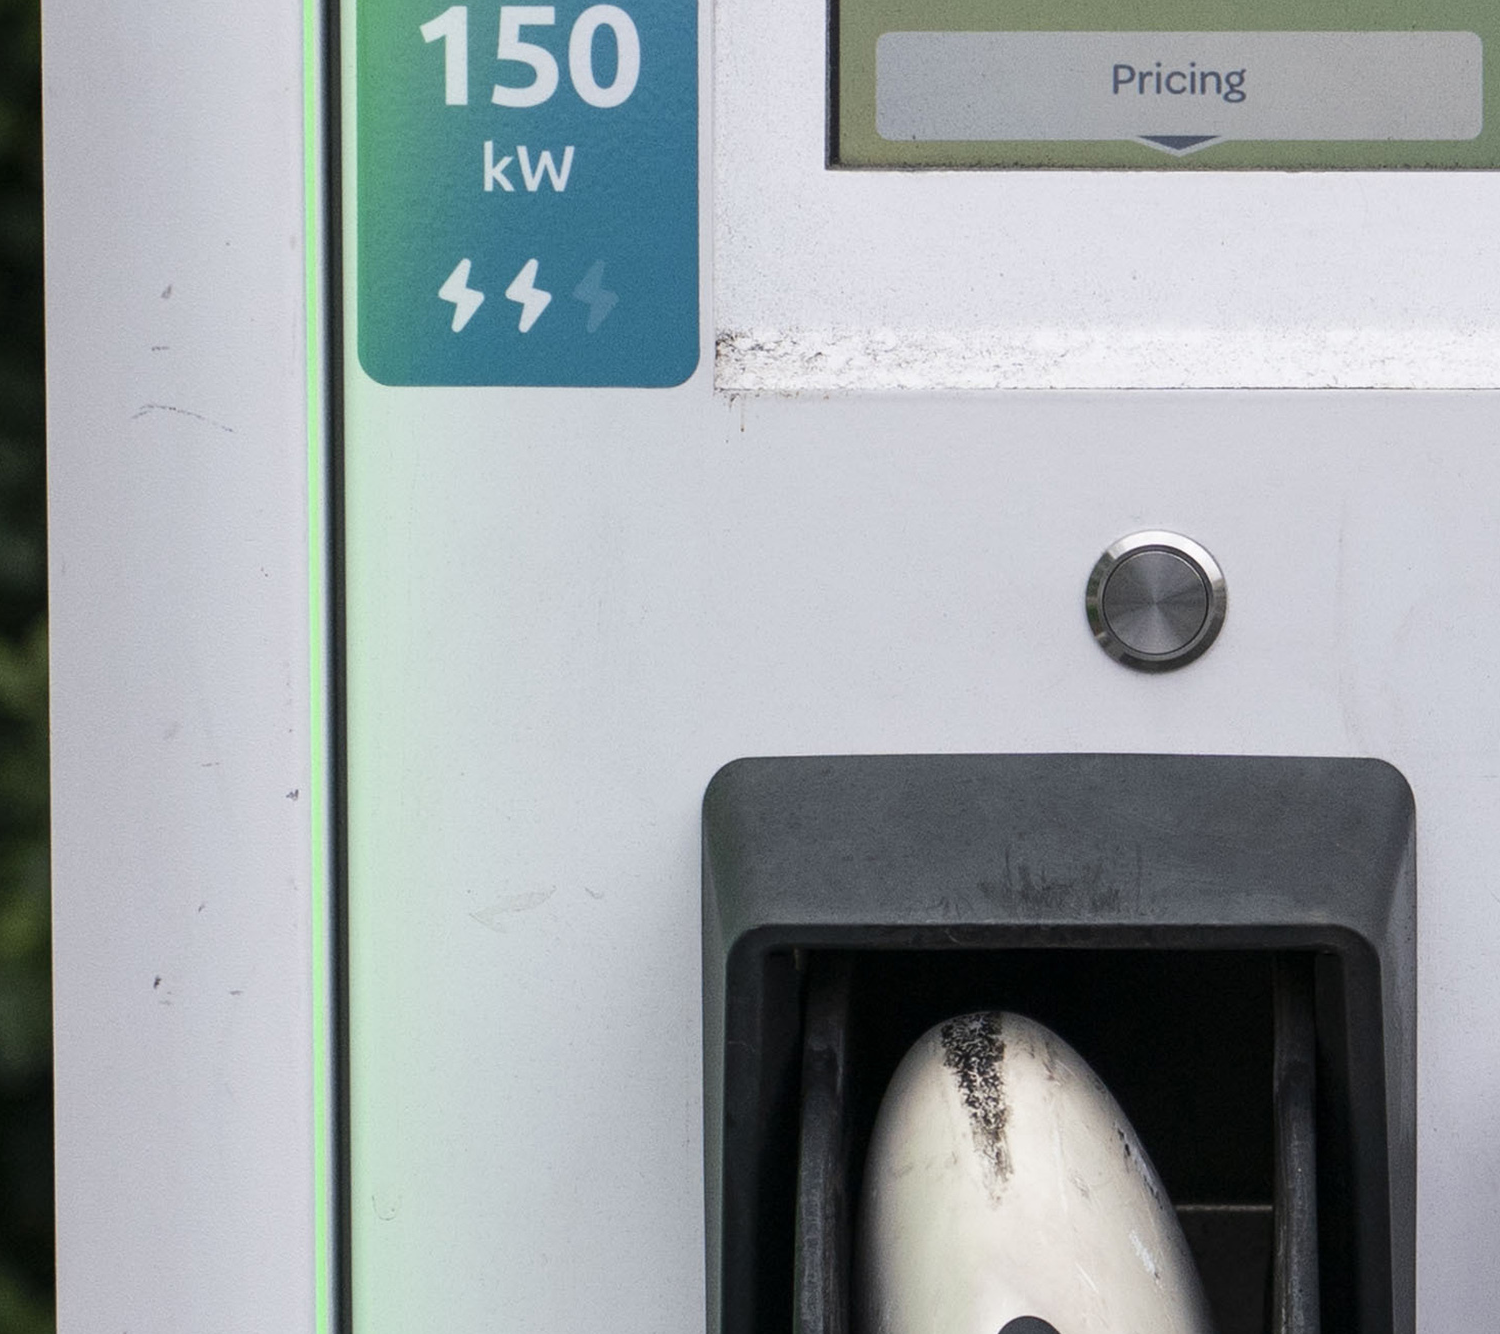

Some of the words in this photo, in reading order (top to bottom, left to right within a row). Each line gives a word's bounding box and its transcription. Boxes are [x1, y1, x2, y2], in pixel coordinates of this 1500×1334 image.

[419, 4, 641, 108] 150
[1112, 61, 1247, 104] Pricing
[483, 140, 575, 192] kW
